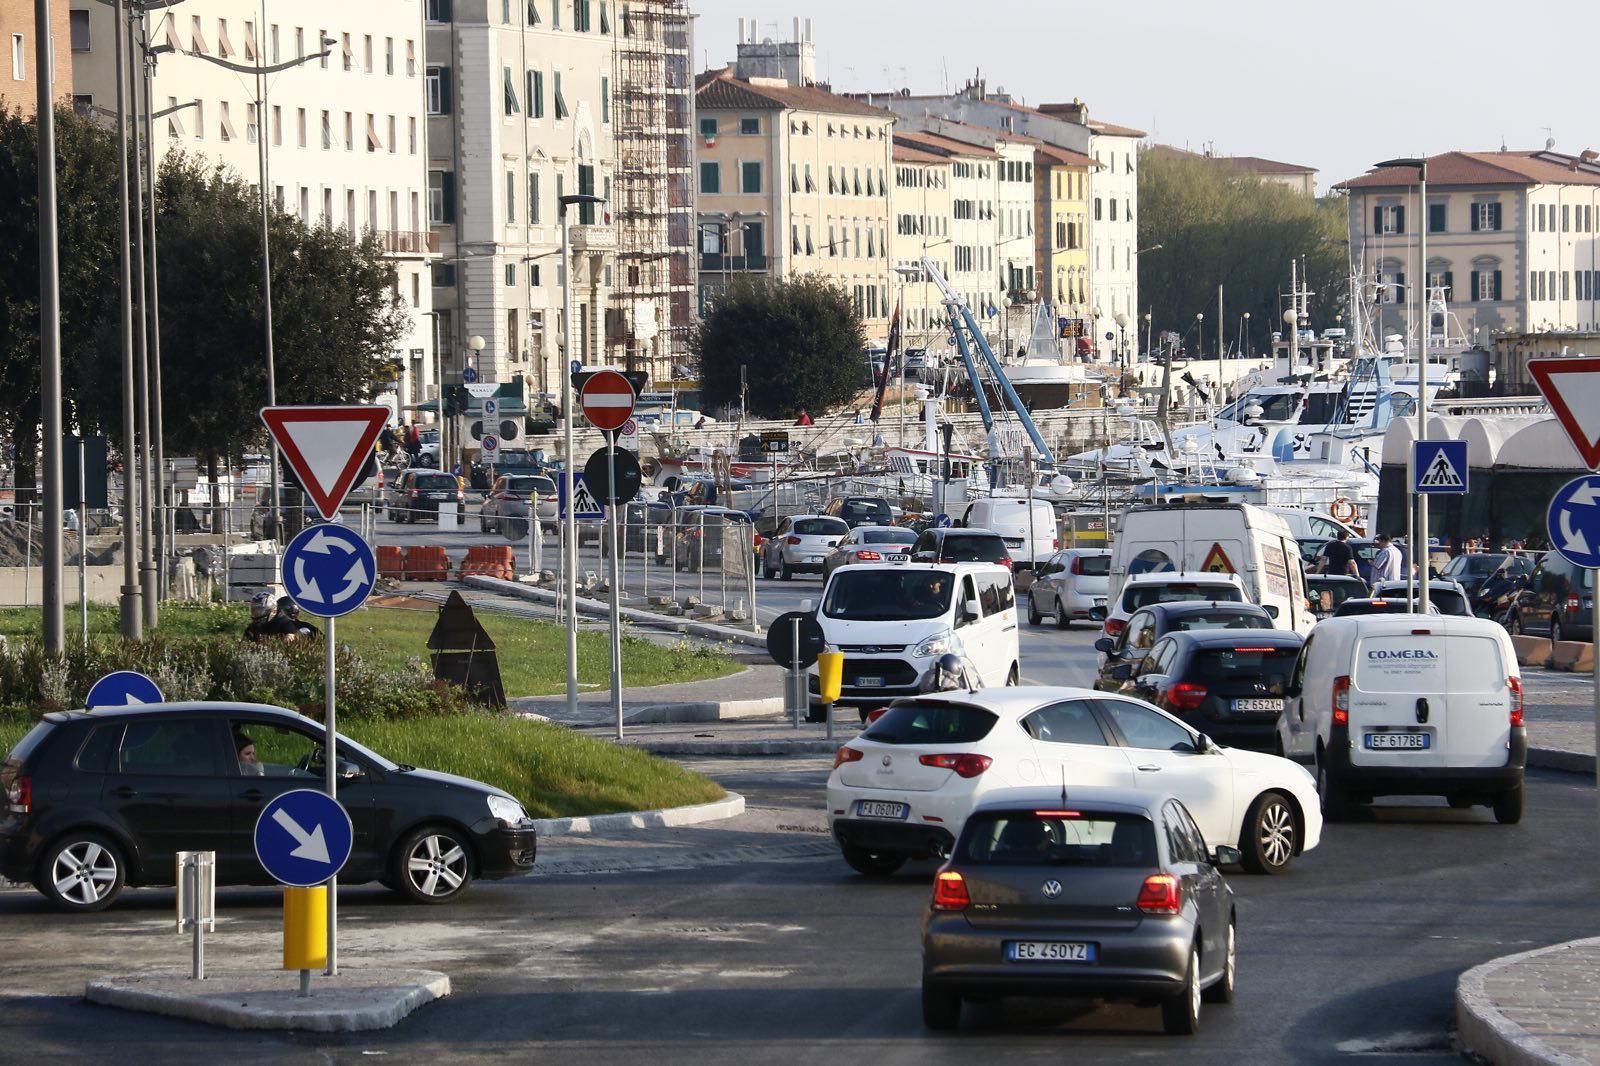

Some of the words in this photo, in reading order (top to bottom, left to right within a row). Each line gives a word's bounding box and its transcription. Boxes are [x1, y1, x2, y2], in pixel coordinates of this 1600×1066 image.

[1367, 650, 1439, 660] CO.ME.BA.
[1237, 699, 1249, 711] EZ
[1252, 699, 1283, 711] 652XH
[1372, 735, 1386, 748] EF
[1389, 735, 1424, 748] 617BE
[863, 803, 873, 815] FA
[875, 803, 902, 817] 060XP
[1018, 943, 1035, 958] EG
[1040, 944, 1086, 959] 450YZ
